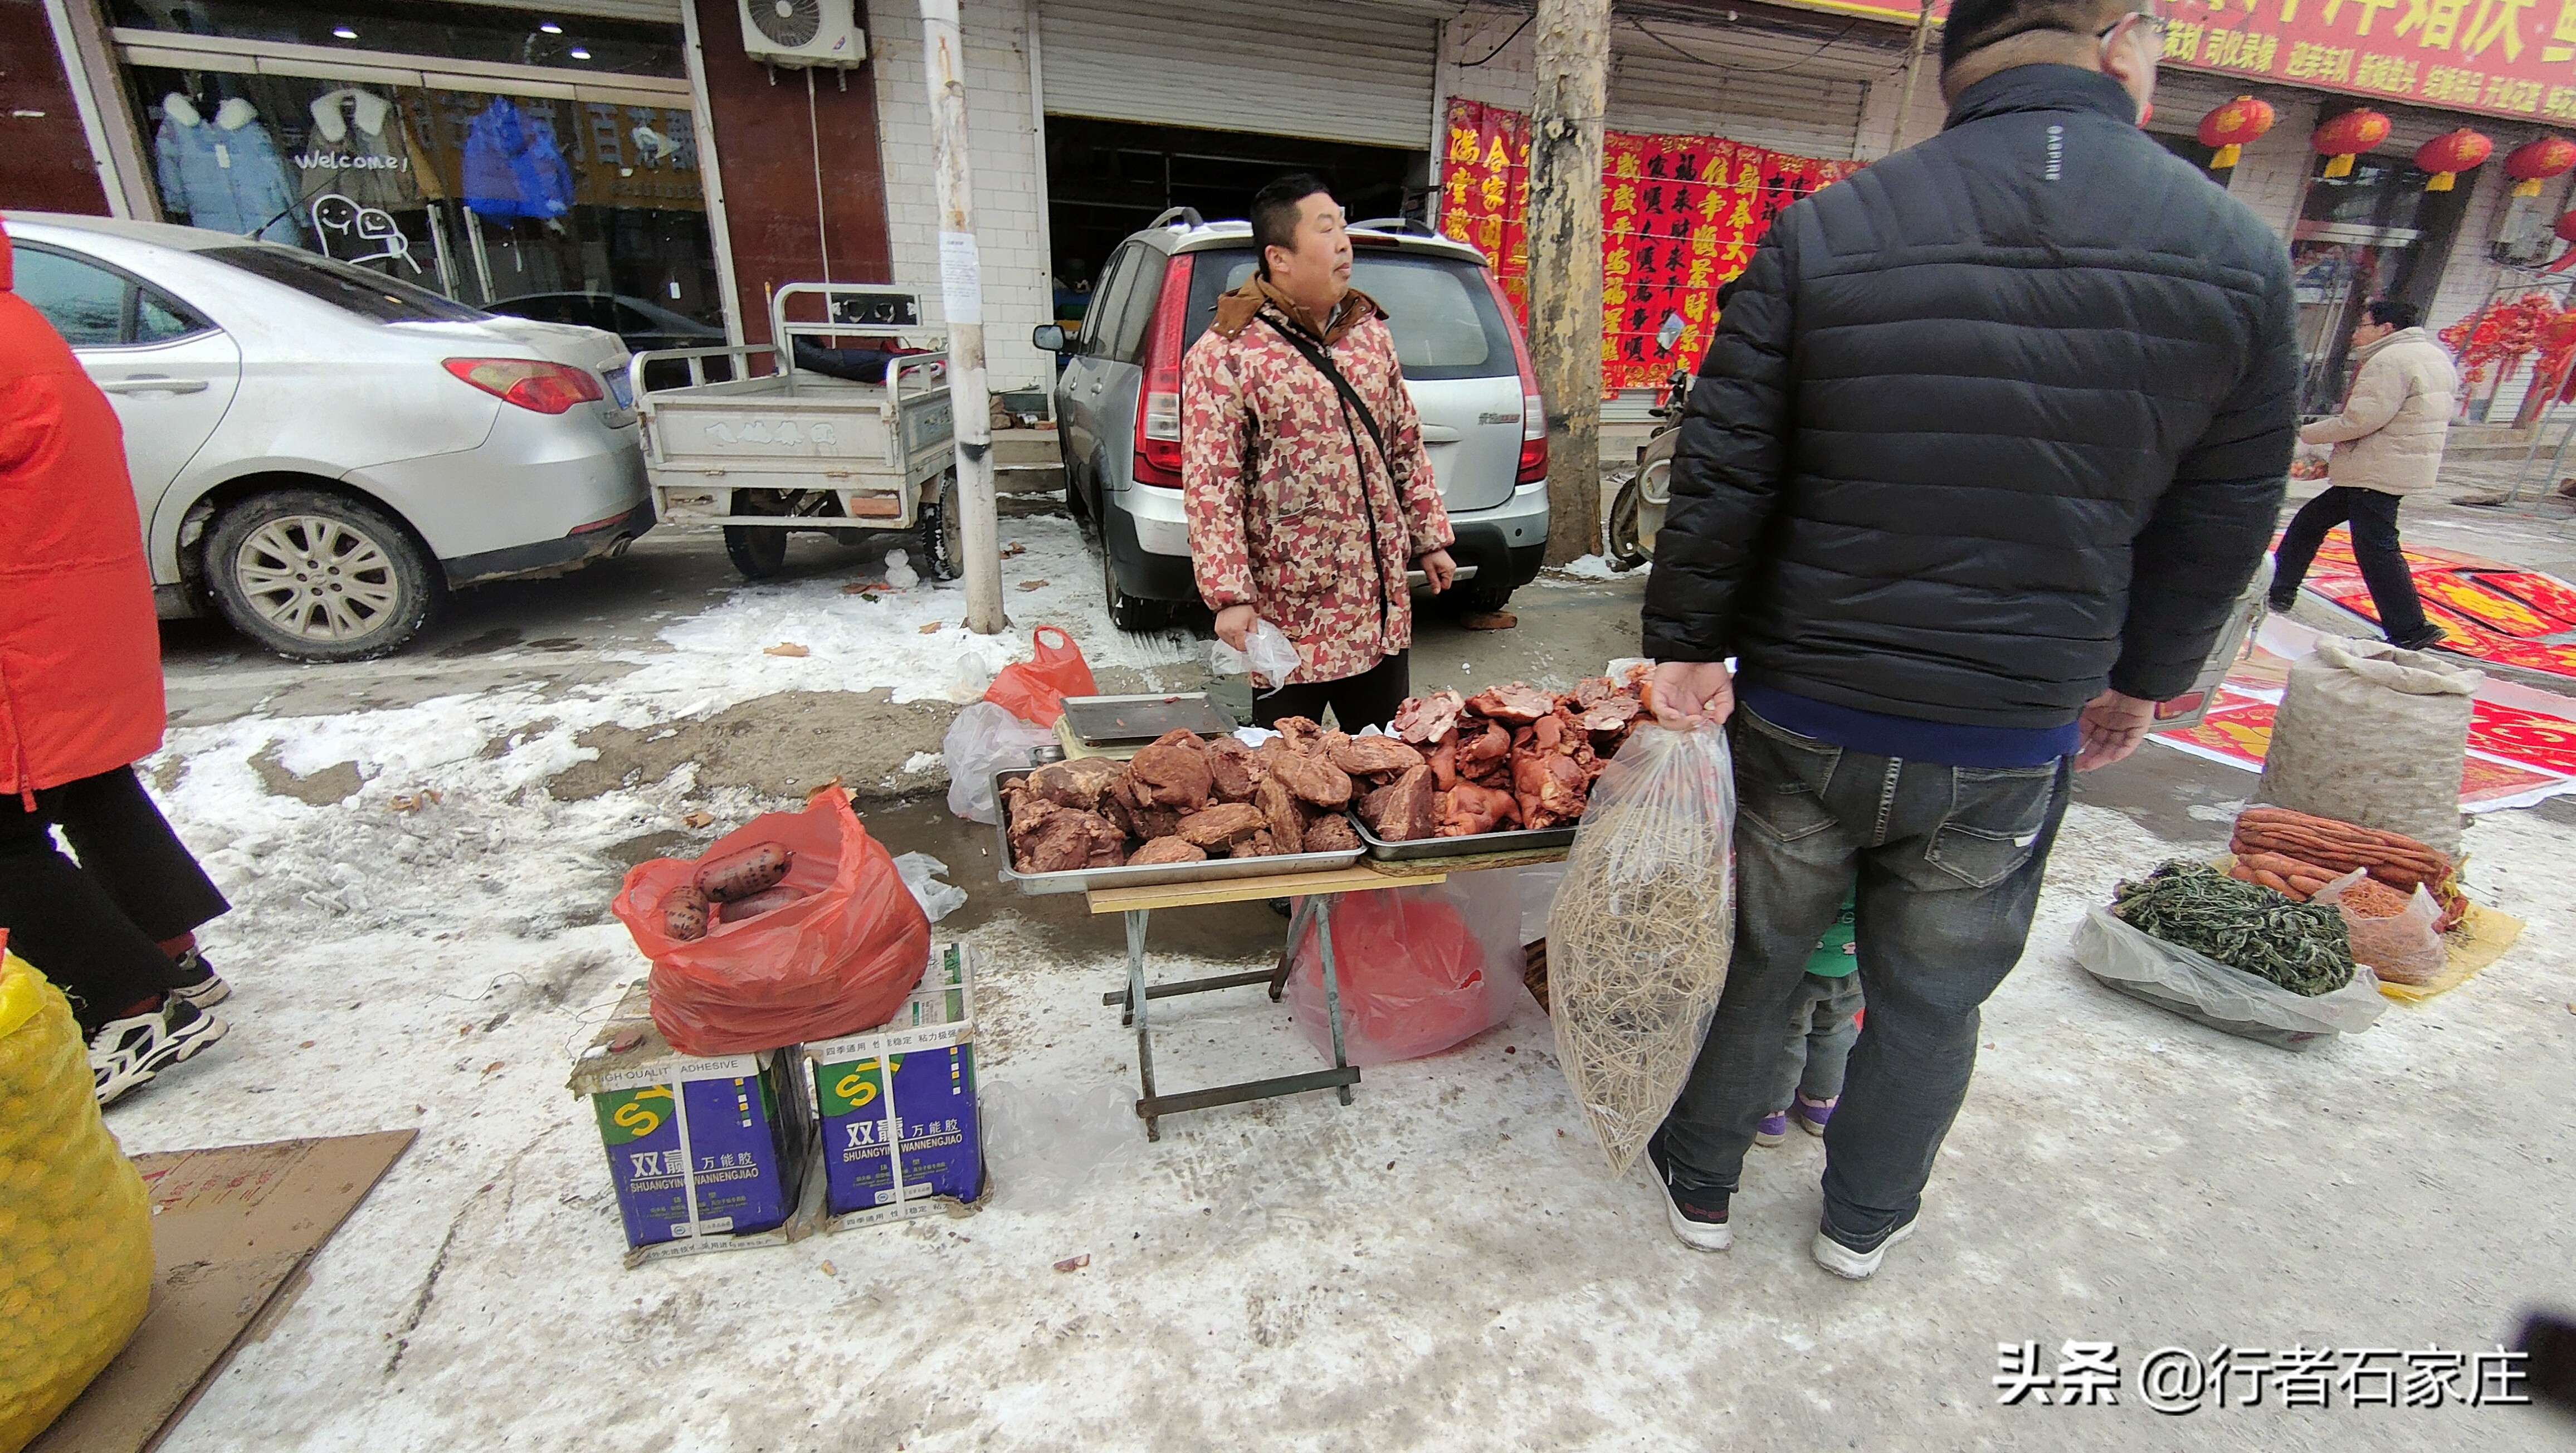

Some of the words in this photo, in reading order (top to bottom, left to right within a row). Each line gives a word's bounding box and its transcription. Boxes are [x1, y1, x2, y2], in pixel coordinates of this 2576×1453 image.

[826, 1042, 866, 1056] 四季通用
[918, 1030, 957, 1044] 粘力极强
[625, 1067, 670, 1080] QUALIT
[681, 1060, 739, 1073] ADHESIVE
[911, 1118, 958, 1138] 万能胶
[843, 1147, 891, 1163] SHUANGYI
[901, 1133, 963, 1153] WANNENGJIAO
[701, 1152, 753, 1170] 万能胶
[846, 1213, 885, 1226] 四季通用
[890, 1205, 928, 1218] 性稳定
